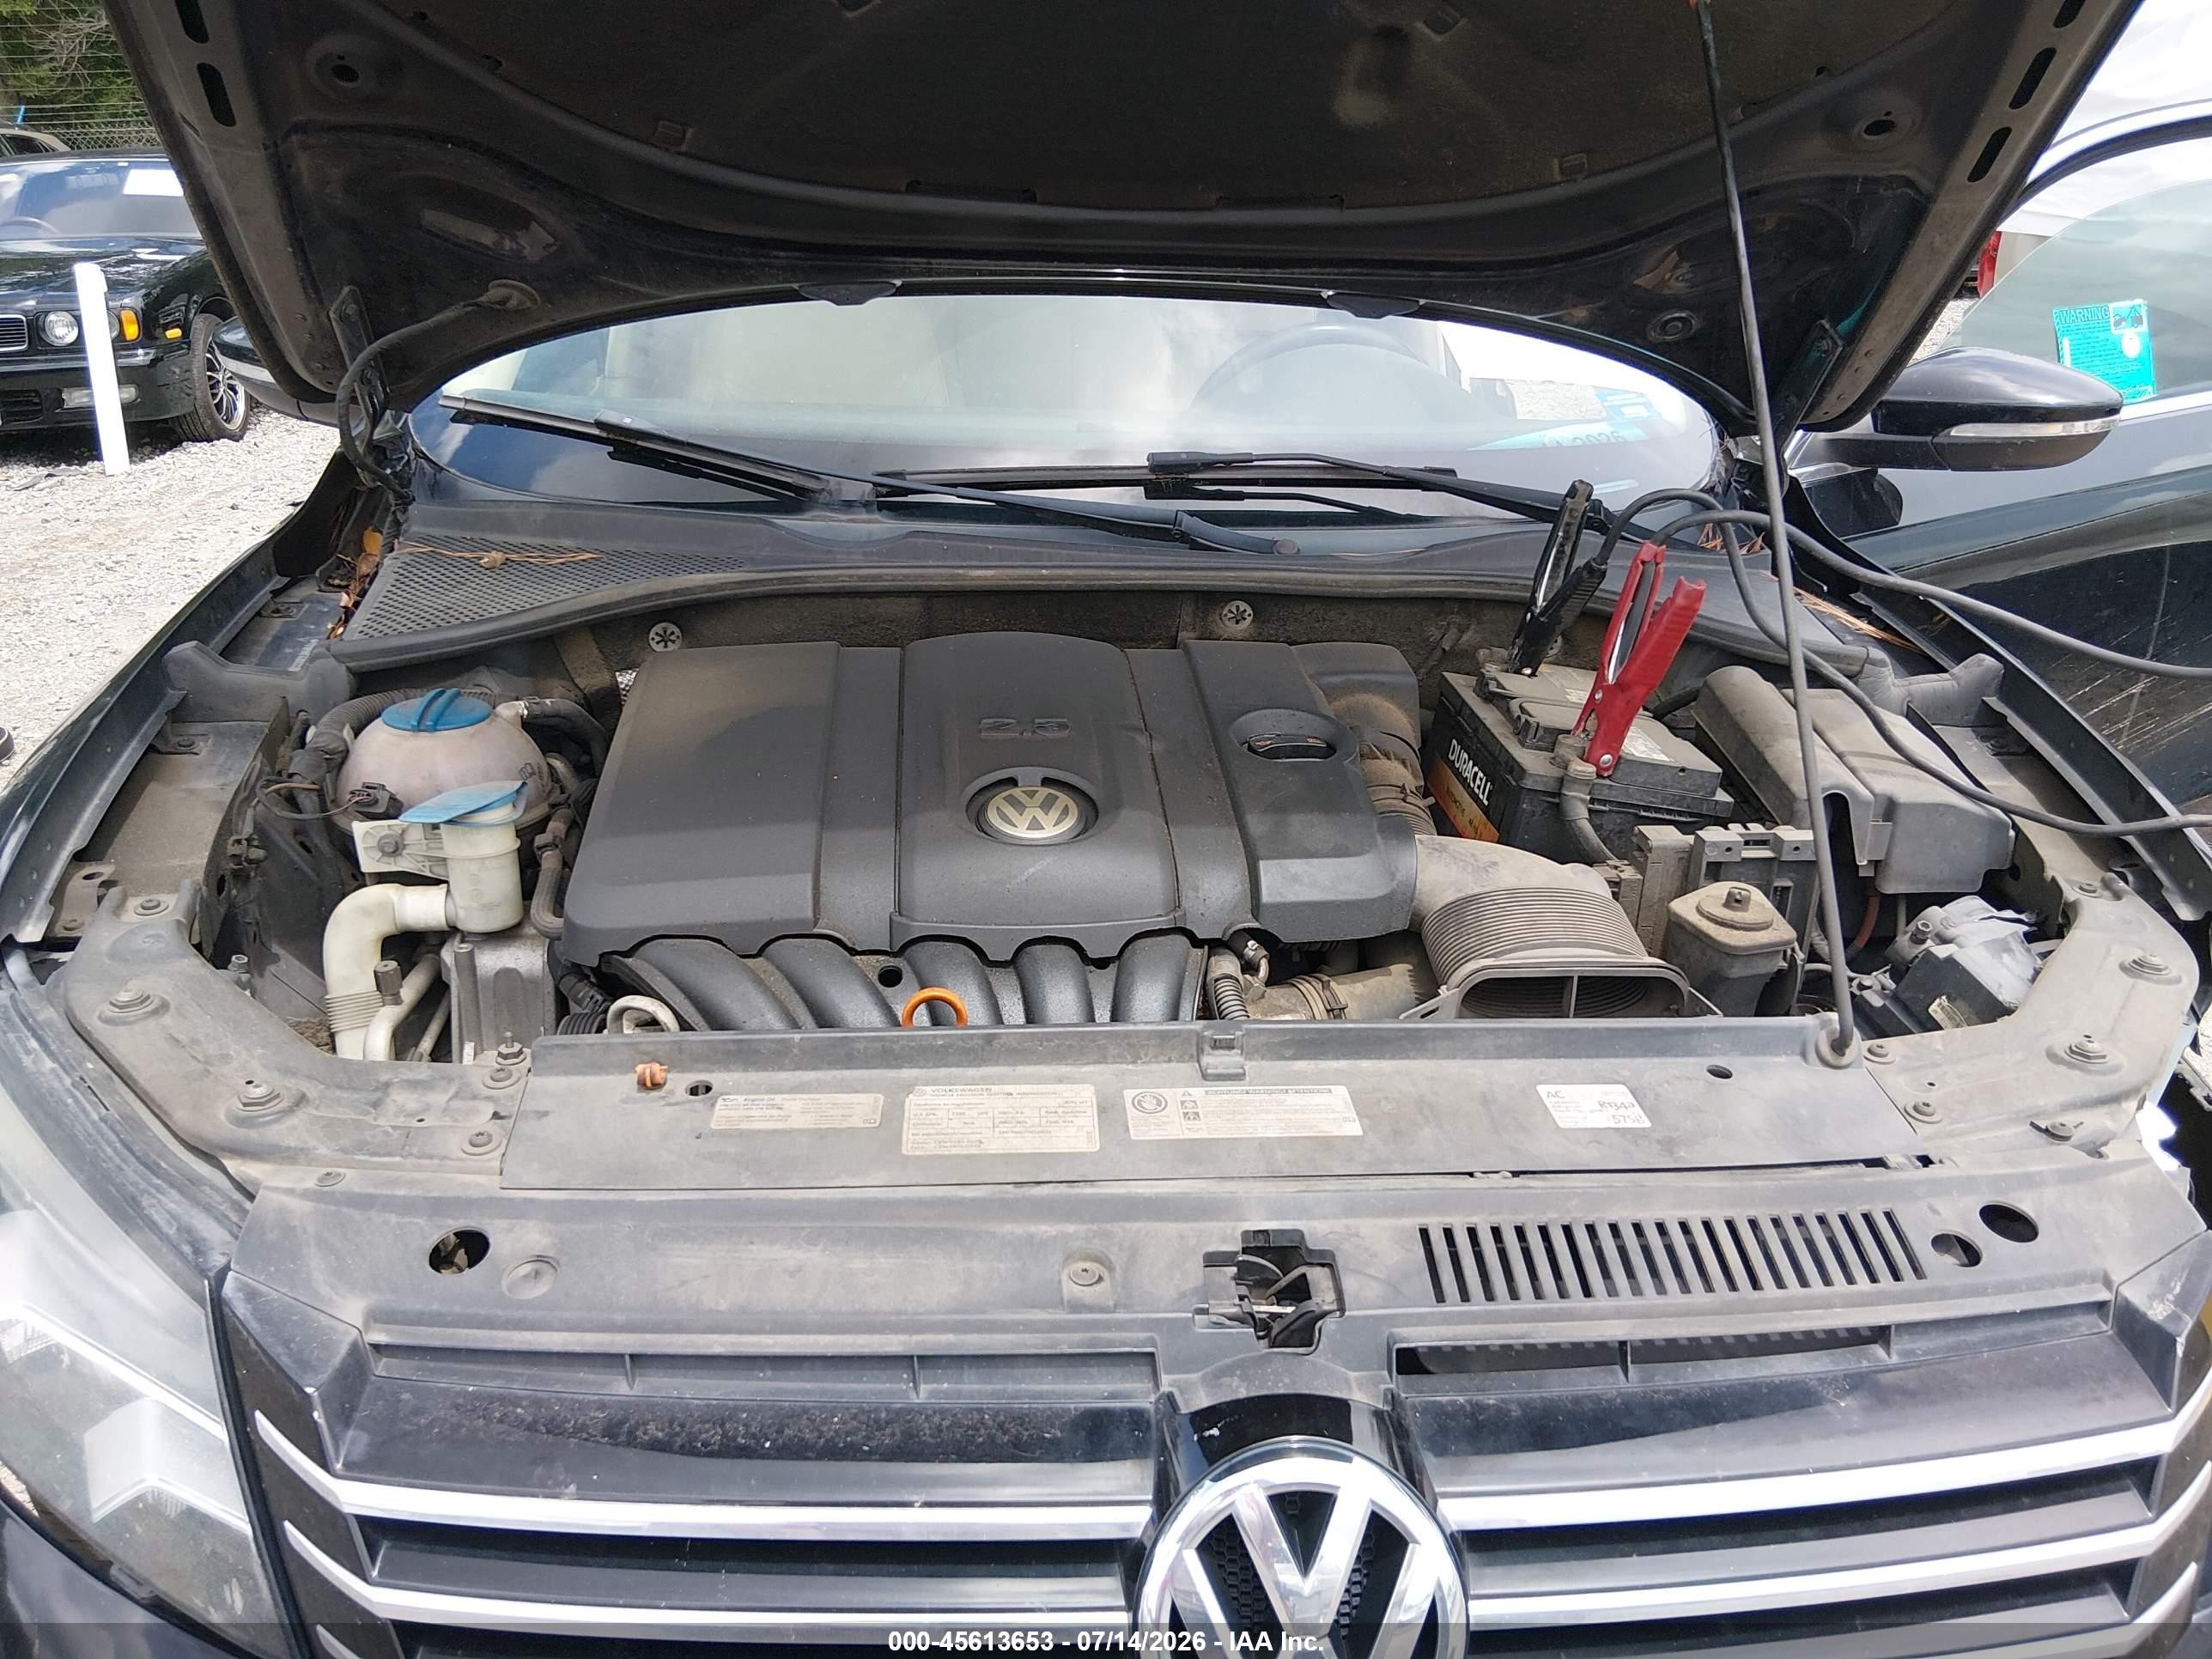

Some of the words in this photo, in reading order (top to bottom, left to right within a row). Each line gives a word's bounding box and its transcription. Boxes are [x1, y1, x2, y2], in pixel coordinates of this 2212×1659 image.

[2059, 306, 2109, 324] WARNING
[1449, 738, 1492, 806] DURACELL
[1547, 1090, 1565, 1099] AC
